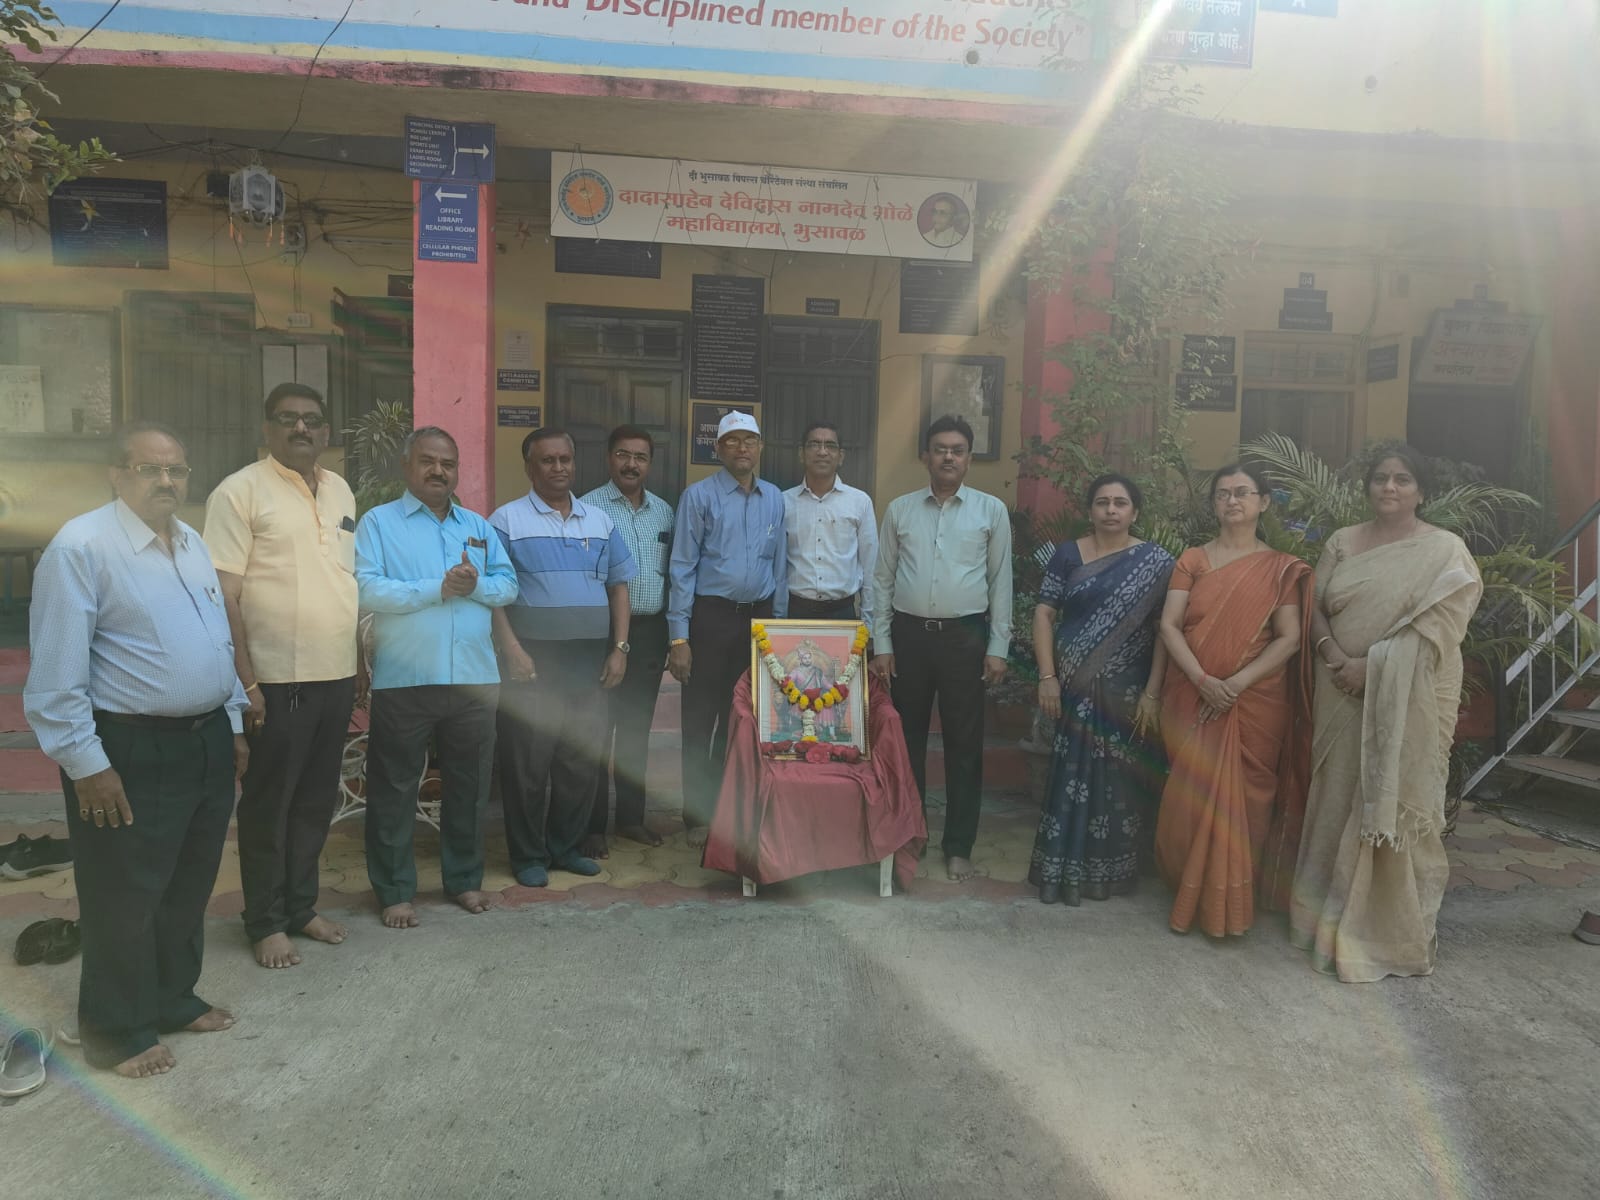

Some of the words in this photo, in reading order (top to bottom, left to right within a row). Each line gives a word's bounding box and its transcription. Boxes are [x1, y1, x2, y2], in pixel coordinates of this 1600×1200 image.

[771, 6, 886, 35] member
[892, 12, 921, 39] of
[923, 14, 966, 41] the
[437, 216, 463, 224] LIBRARY
[425, 224, 453, 232] READING
[793, 222, 867, 243] भुसावळ
